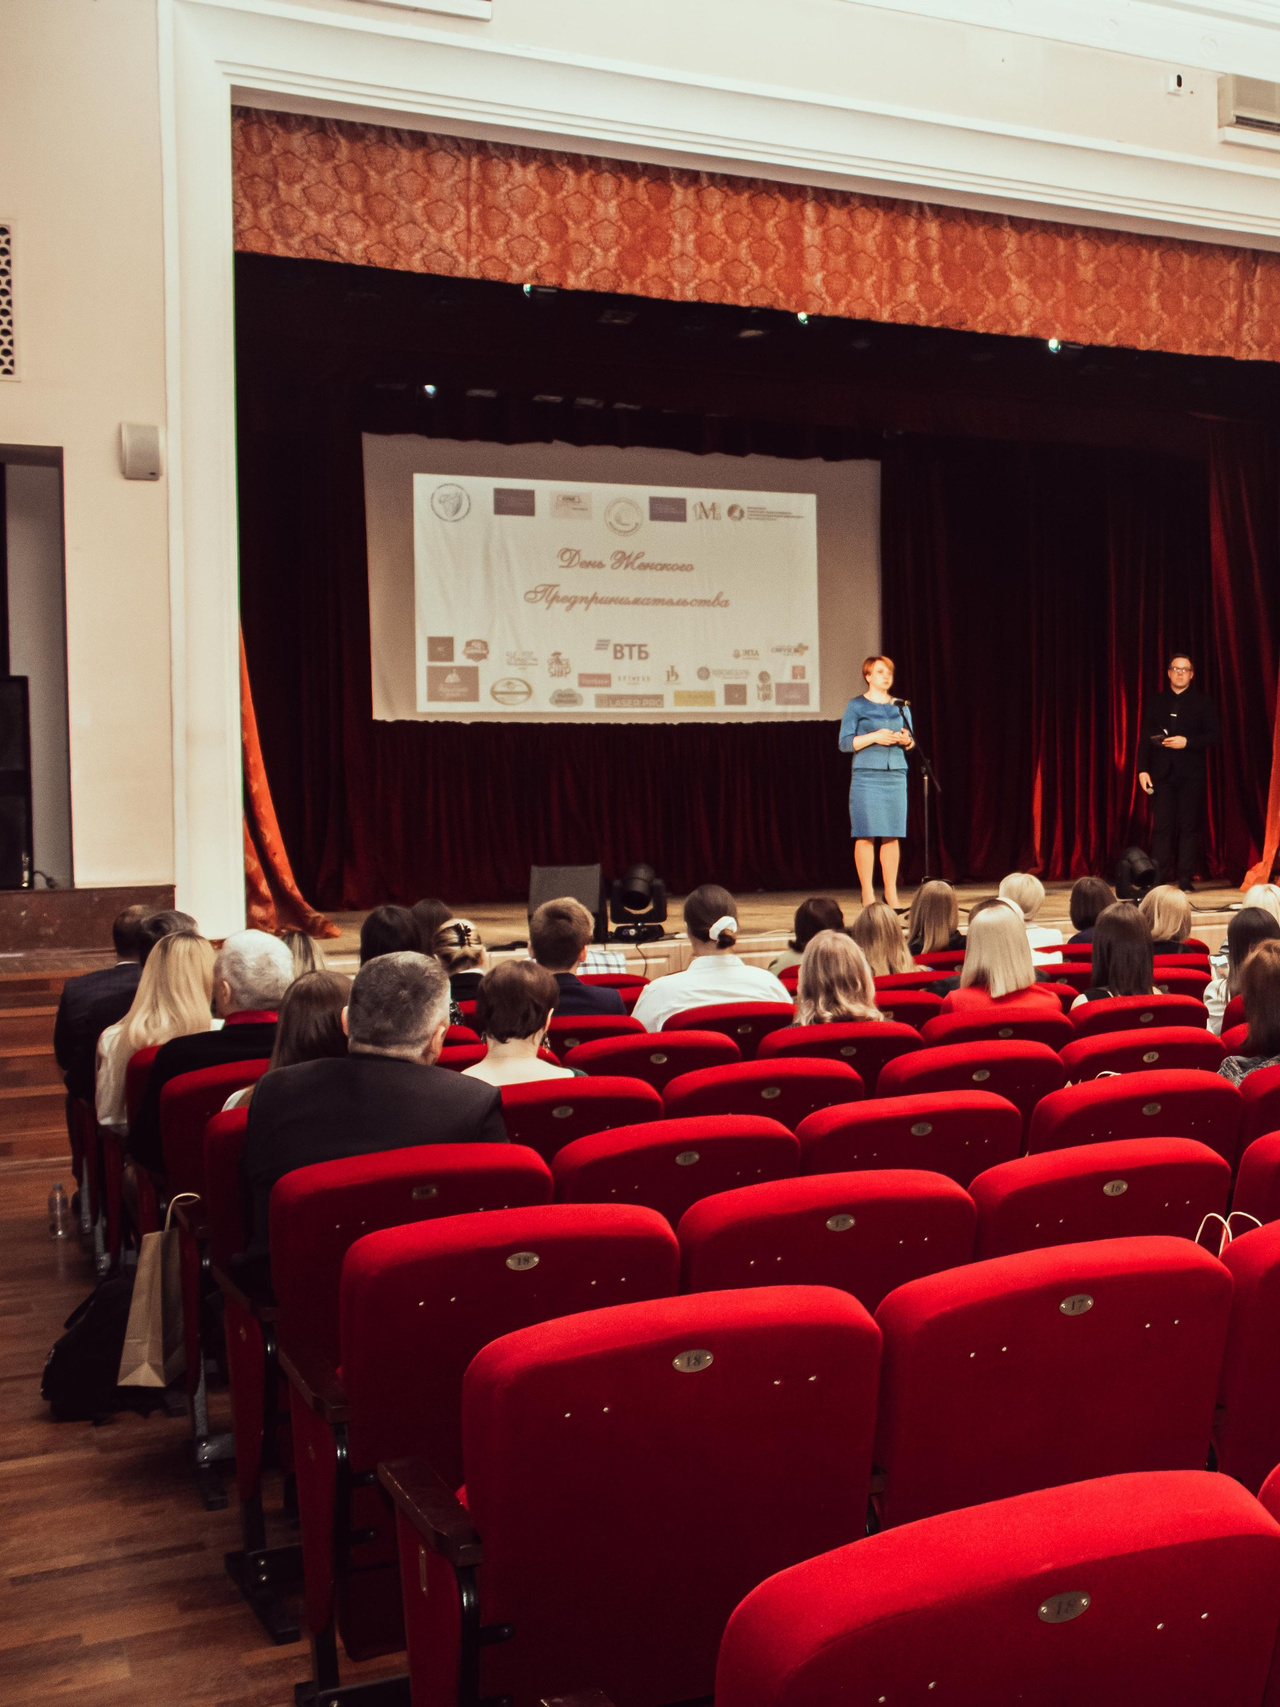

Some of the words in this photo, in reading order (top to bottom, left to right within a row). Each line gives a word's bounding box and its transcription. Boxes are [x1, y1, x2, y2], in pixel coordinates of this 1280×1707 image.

[557, 548, 606, 569] День
[610, 550, 695, 572] Женского
[523, 584, 730, 612] Предпринимательства
[613, 643, 650, 661] ВТБ
[609, 699, 640, 708] LASER
[642, 699, 663, 708] PRO
[1071, 1298, 1085, 1311] 17
[687, 1355, 701, 1368] 18
[1055, 1598, 1075, 1617] 18
